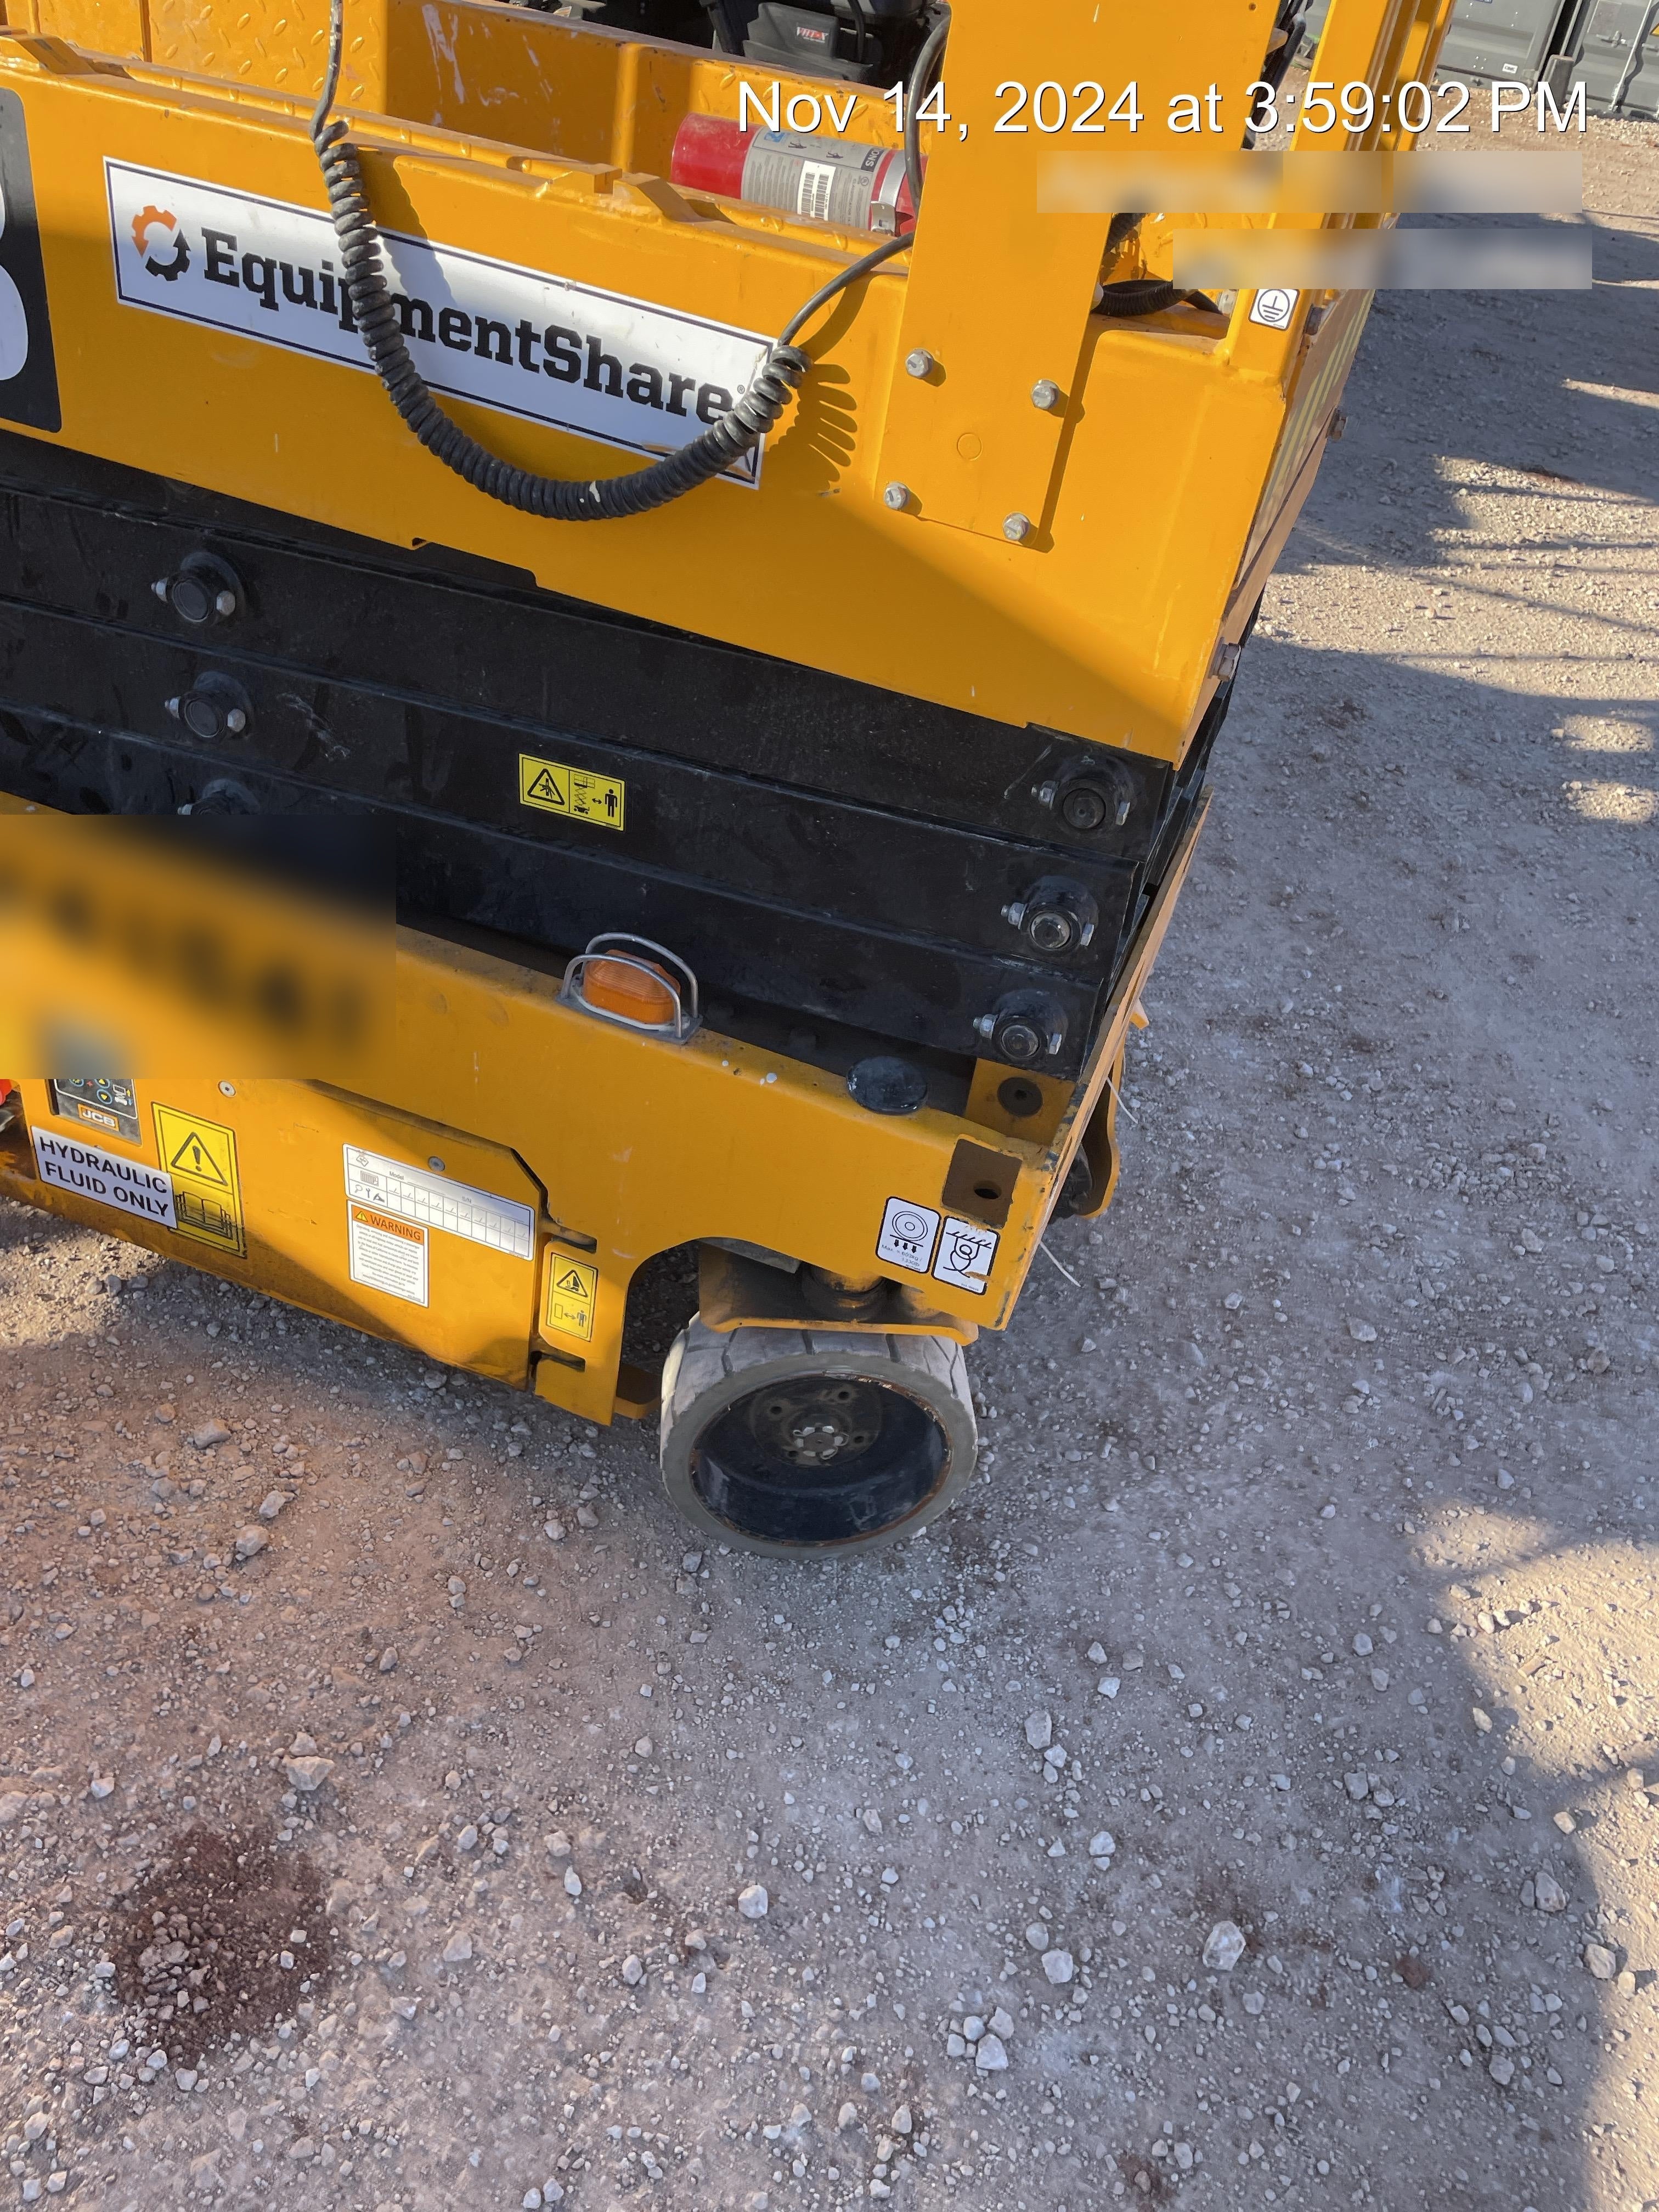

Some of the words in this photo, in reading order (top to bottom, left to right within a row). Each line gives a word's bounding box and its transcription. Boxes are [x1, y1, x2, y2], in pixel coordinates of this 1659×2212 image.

[82, 1109, 115, 1127] JCB
[39, 1136, 168, 1193] HYDRAULIC
[389, 1171, 404, 1180] Model
[44, 1160, 106, 1194] FLUID
[113, 1186, 168, 1217] ONLY
[370, 1214, 421, 1241] WARNING
